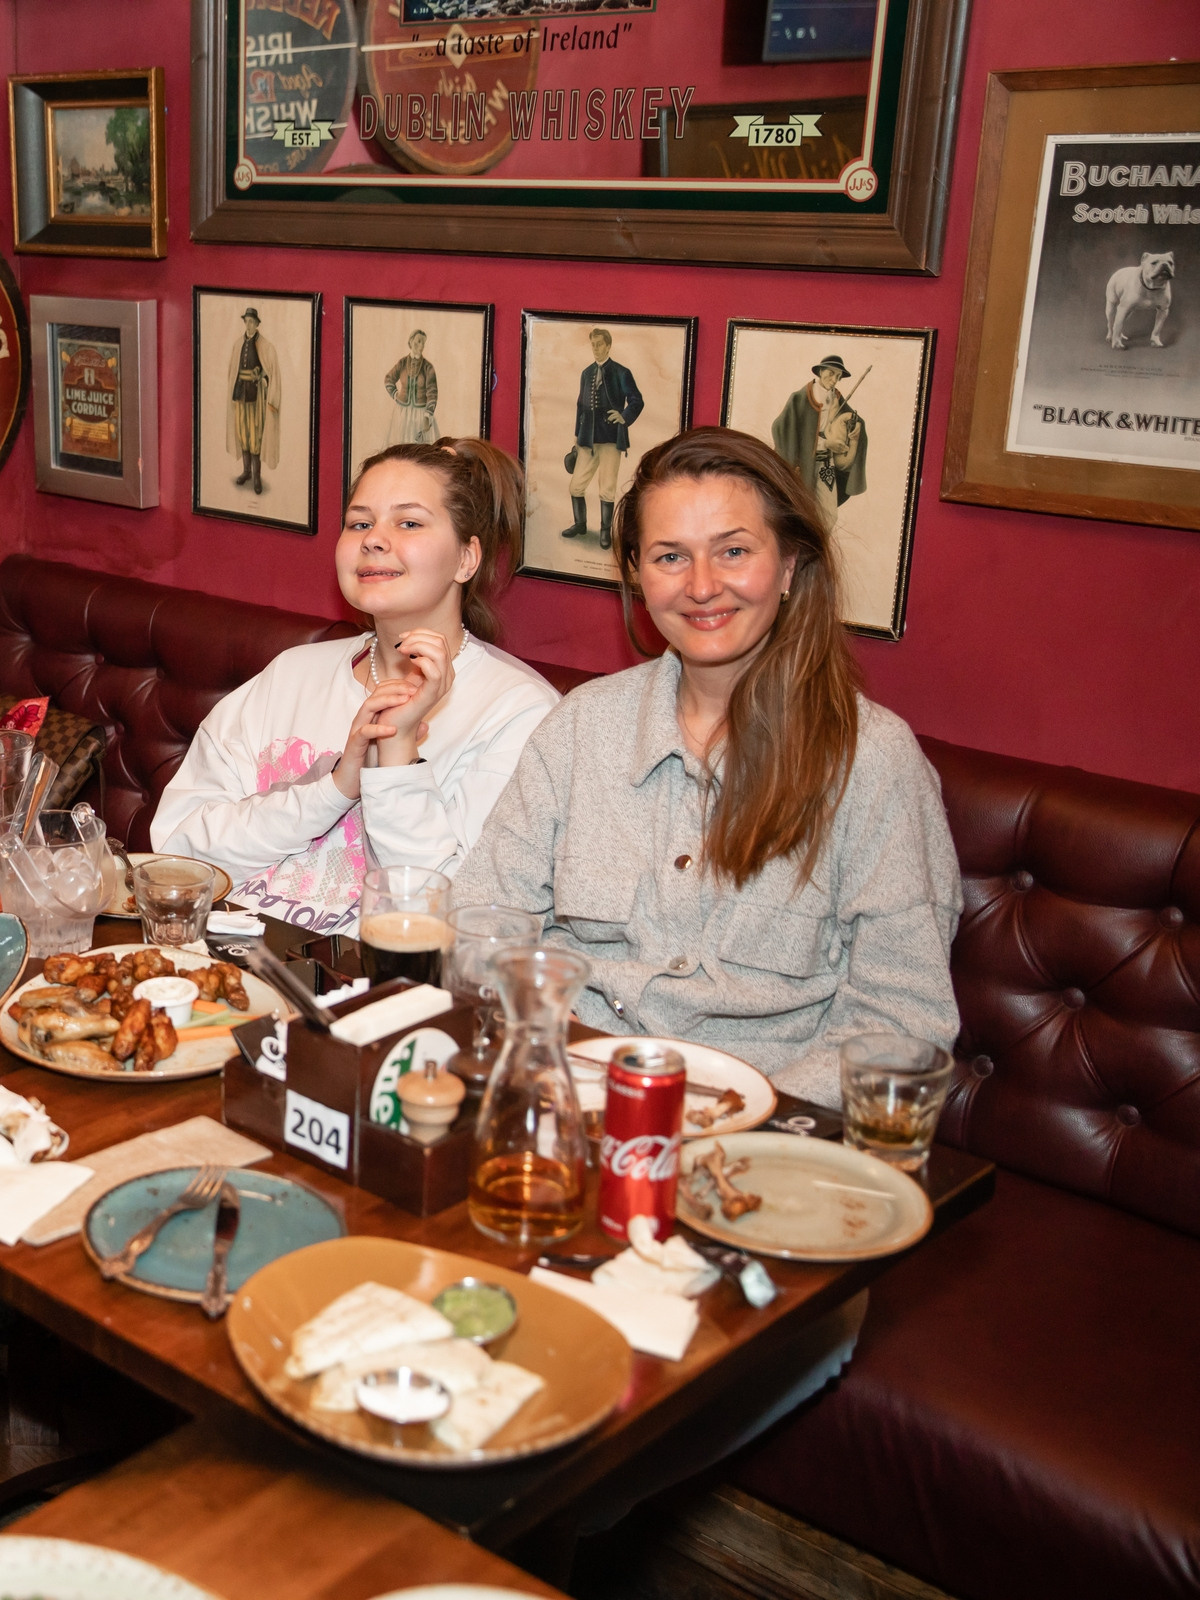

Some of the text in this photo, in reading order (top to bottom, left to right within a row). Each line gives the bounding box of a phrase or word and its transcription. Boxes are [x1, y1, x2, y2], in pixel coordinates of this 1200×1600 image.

[457, 33, 504, 56] taste
[513, 28, 537, 53] of
[359, 92, 486, 141] DUBLIN
[509, 86, 697, 141] WHISKEY
[291, 132, 314, 146] EST.
[753, 127, 798, 145] 1780
[1072, 203, 1149, 223] Scotch
[66, 388, 114, 406] LIME JUICE
[71, 402, 108, 418] CORDIAL
[291, 1109, 342, 1155] 204
